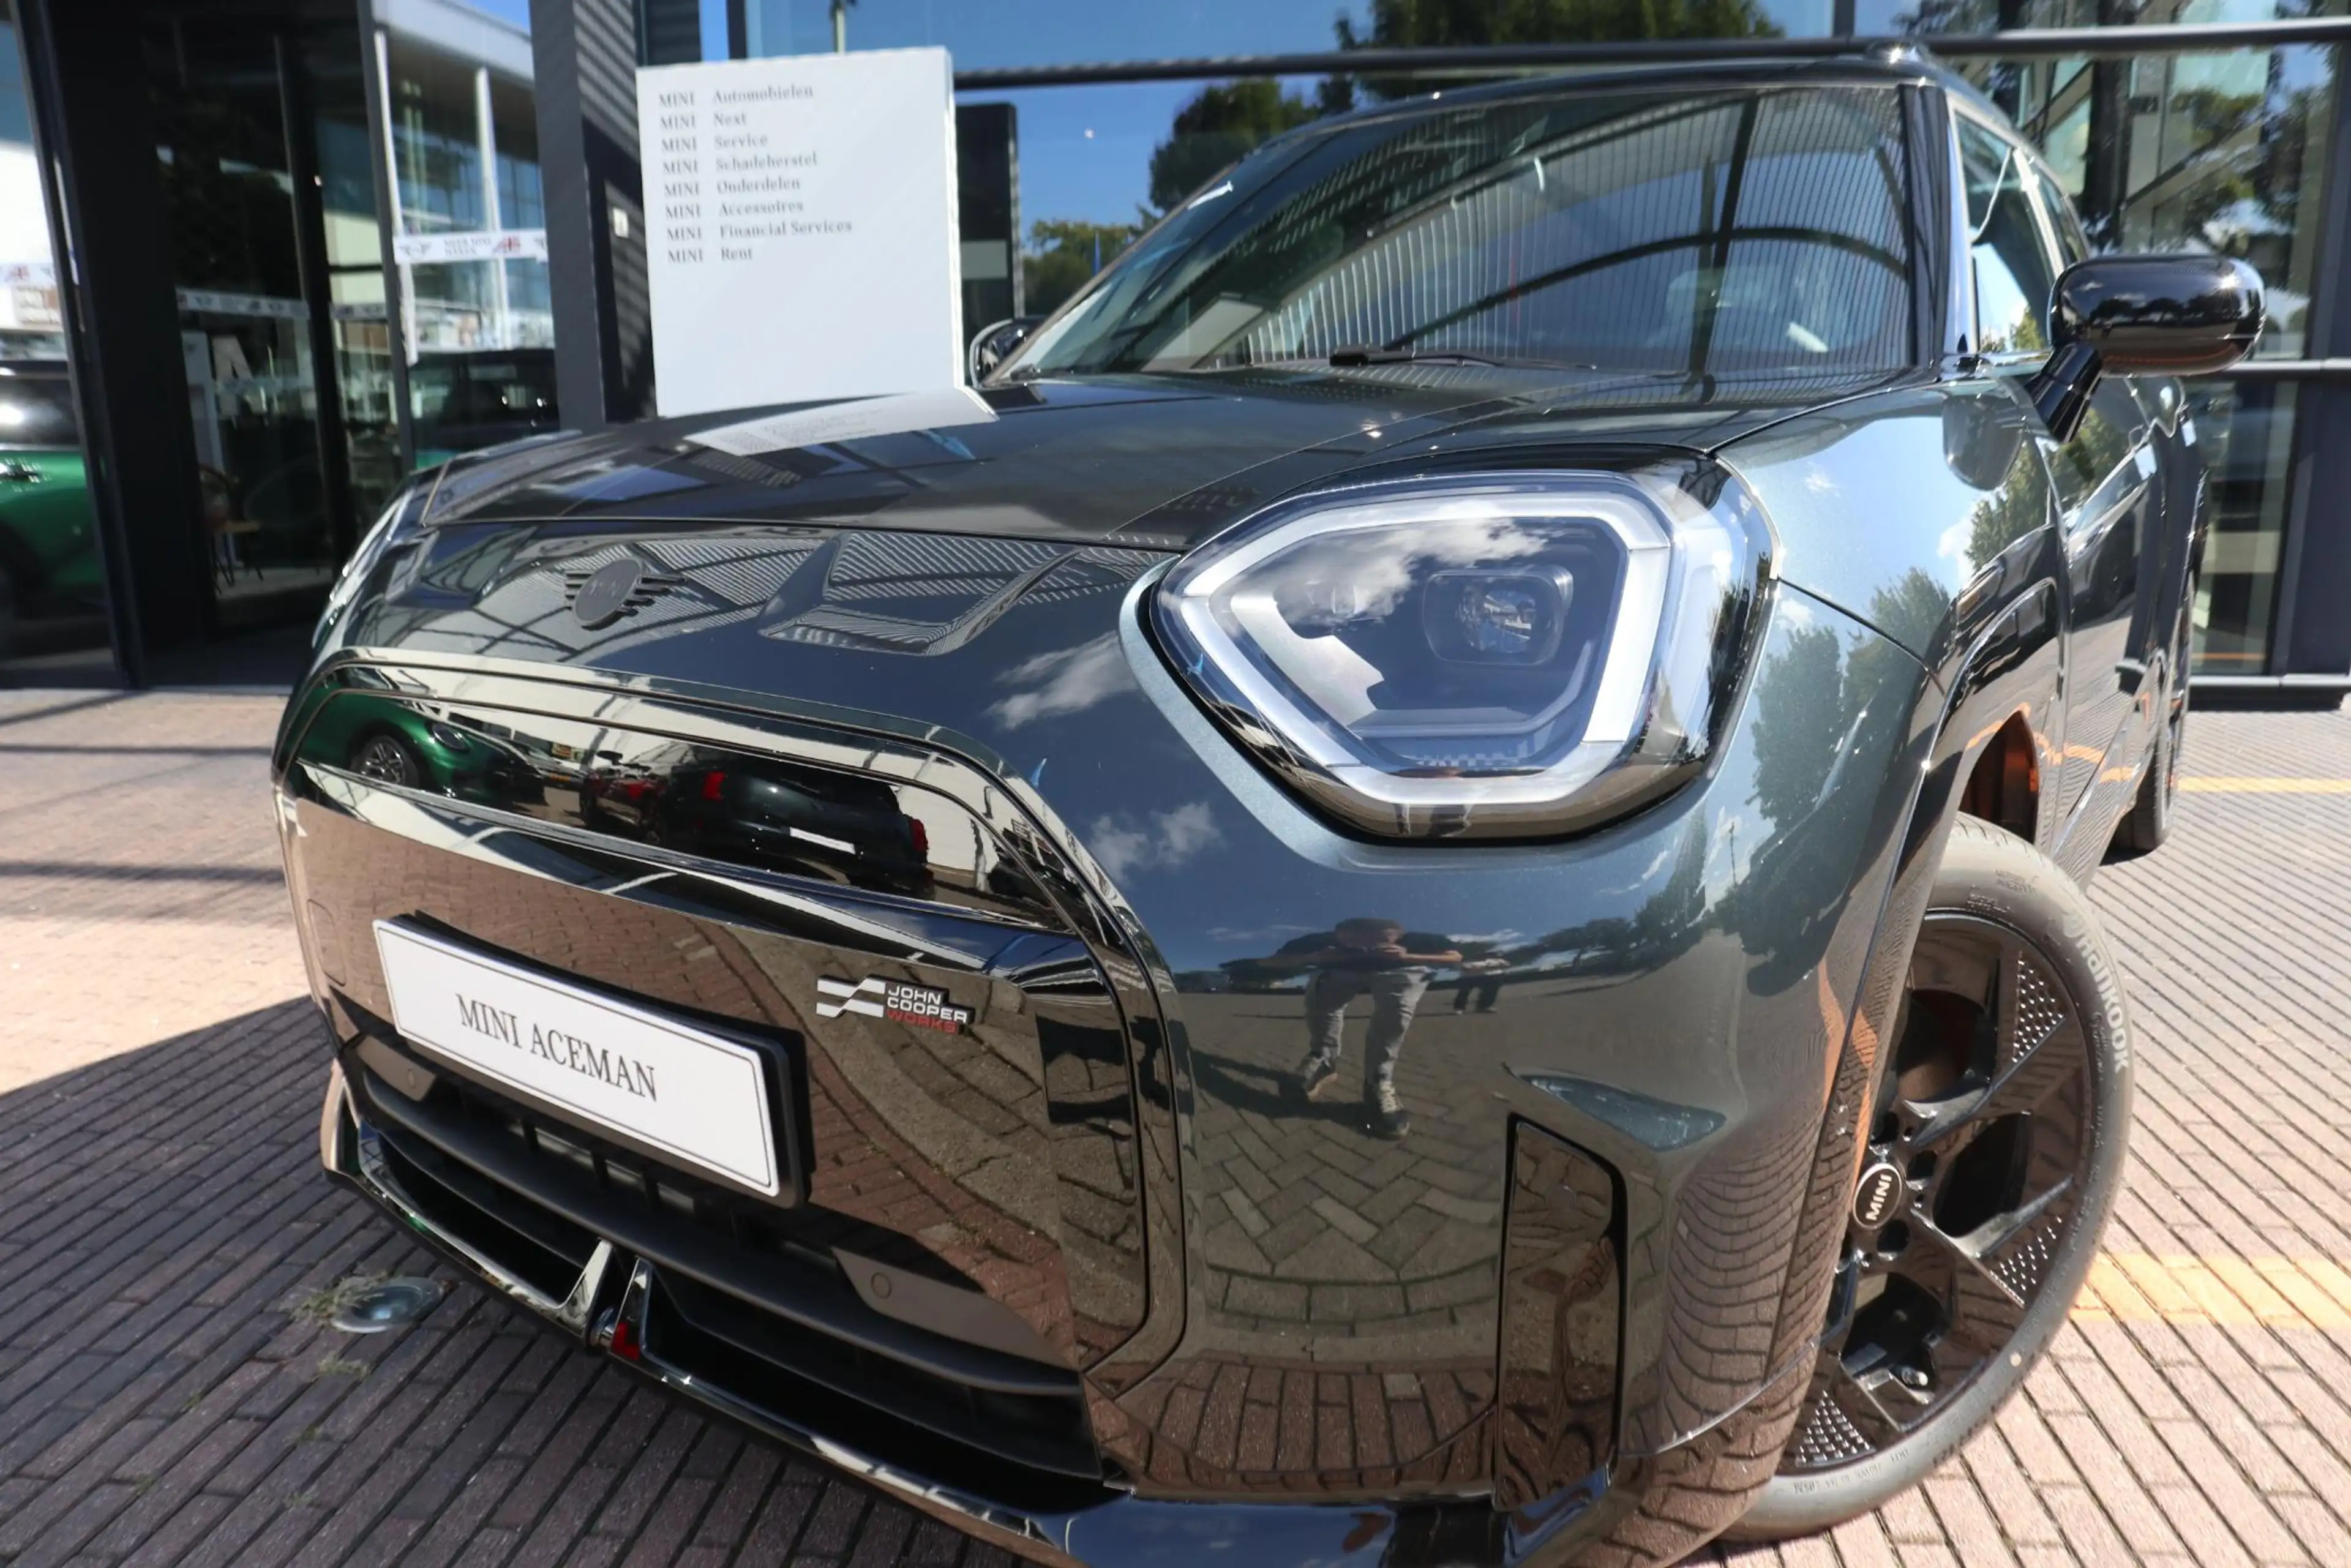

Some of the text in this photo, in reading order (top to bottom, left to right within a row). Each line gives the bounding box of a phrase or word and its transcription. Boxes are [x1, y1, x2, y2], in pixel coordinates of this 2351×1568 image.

[659, 84, 813, 107] MINI Automobielen
[661, 111, 746, 129] MINI Next
[662, 133, 768, 152] MINI Service
[663, 151, 817, 174] MINI Schadeherstel
[665, 176, 800, 197] MINI Onderdelen
[666, 200, 803, 219] MINI Accessoires
[667, 219, 852, 241] MINI Financial Services
[668, 246, 753, 263] MINI Rent
[888, 985, 941, 1005] JOHN
[888, 997, 968, 1024] COOPER
[888, 1011, 957, 1035] WORKS
[455, 993, 658, 1103] MINI ACEMAN
[1865, 1174, 1892, 1221] MINI
